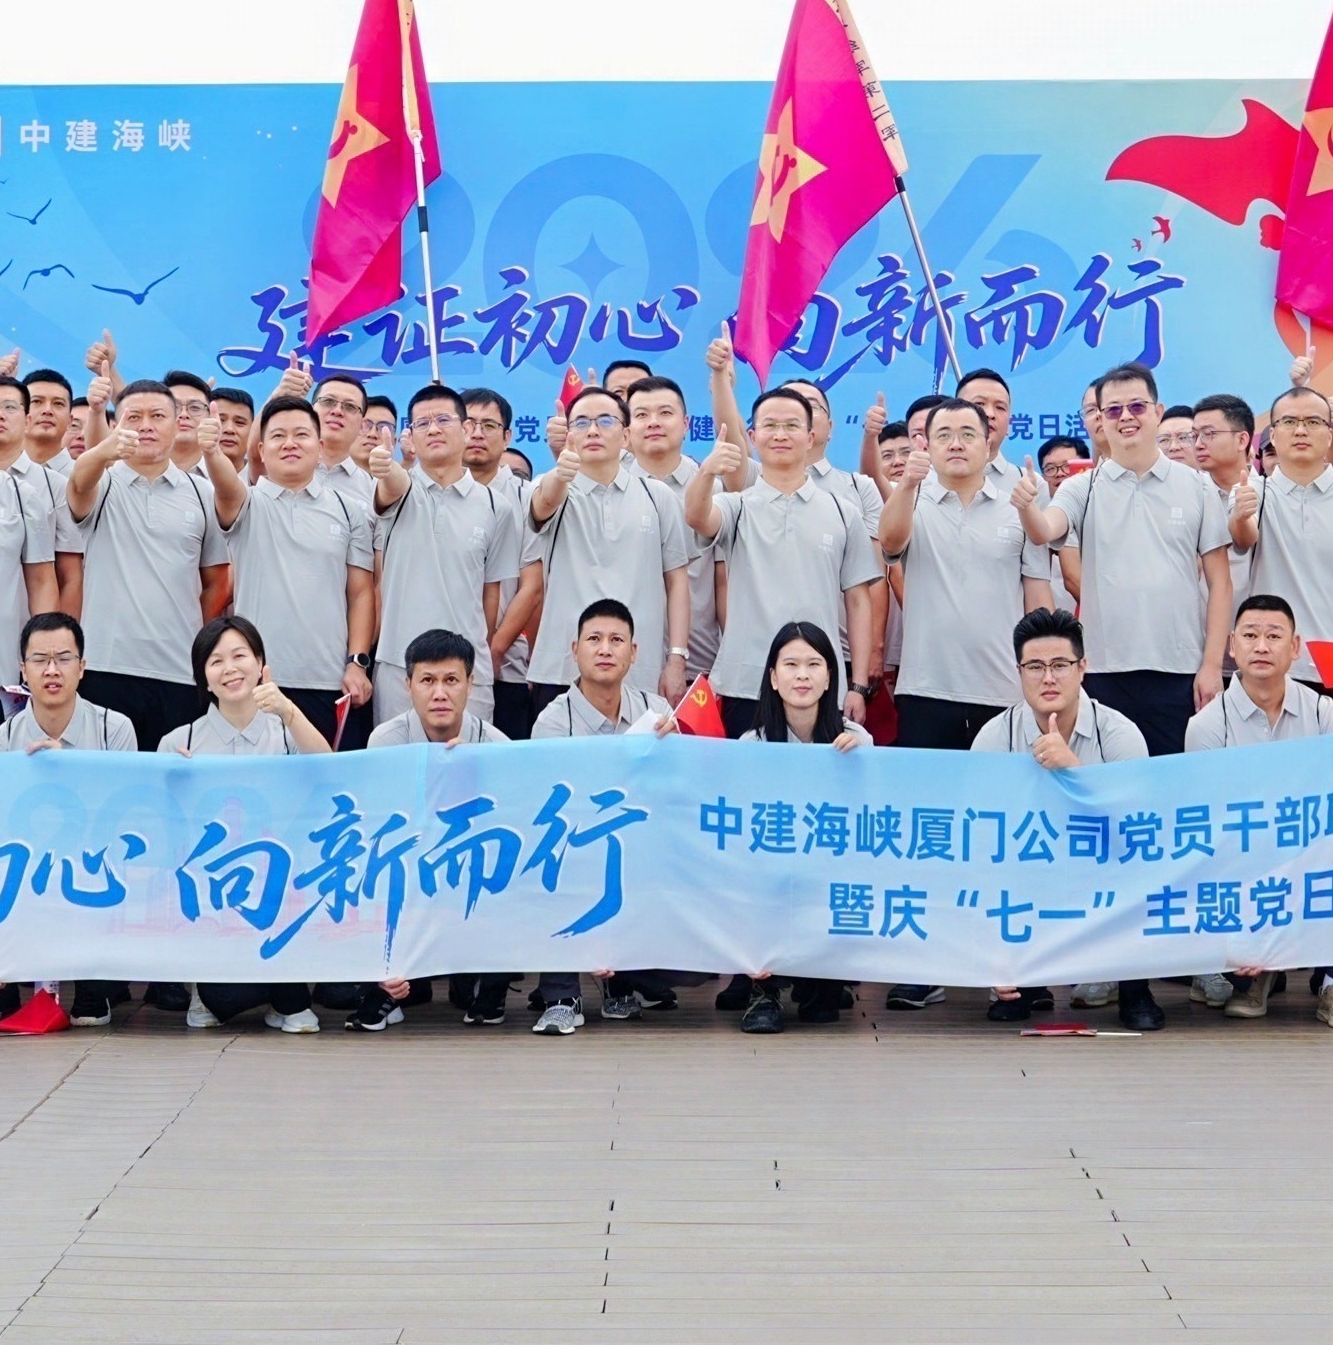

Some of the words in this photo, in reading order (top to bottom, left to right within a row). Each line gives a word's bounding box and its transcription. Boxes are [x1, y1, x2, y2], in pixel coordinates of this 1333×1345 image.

[19, 118, 192, 153] 中建海峡
[174, 782, 650, 973] 向新而行
